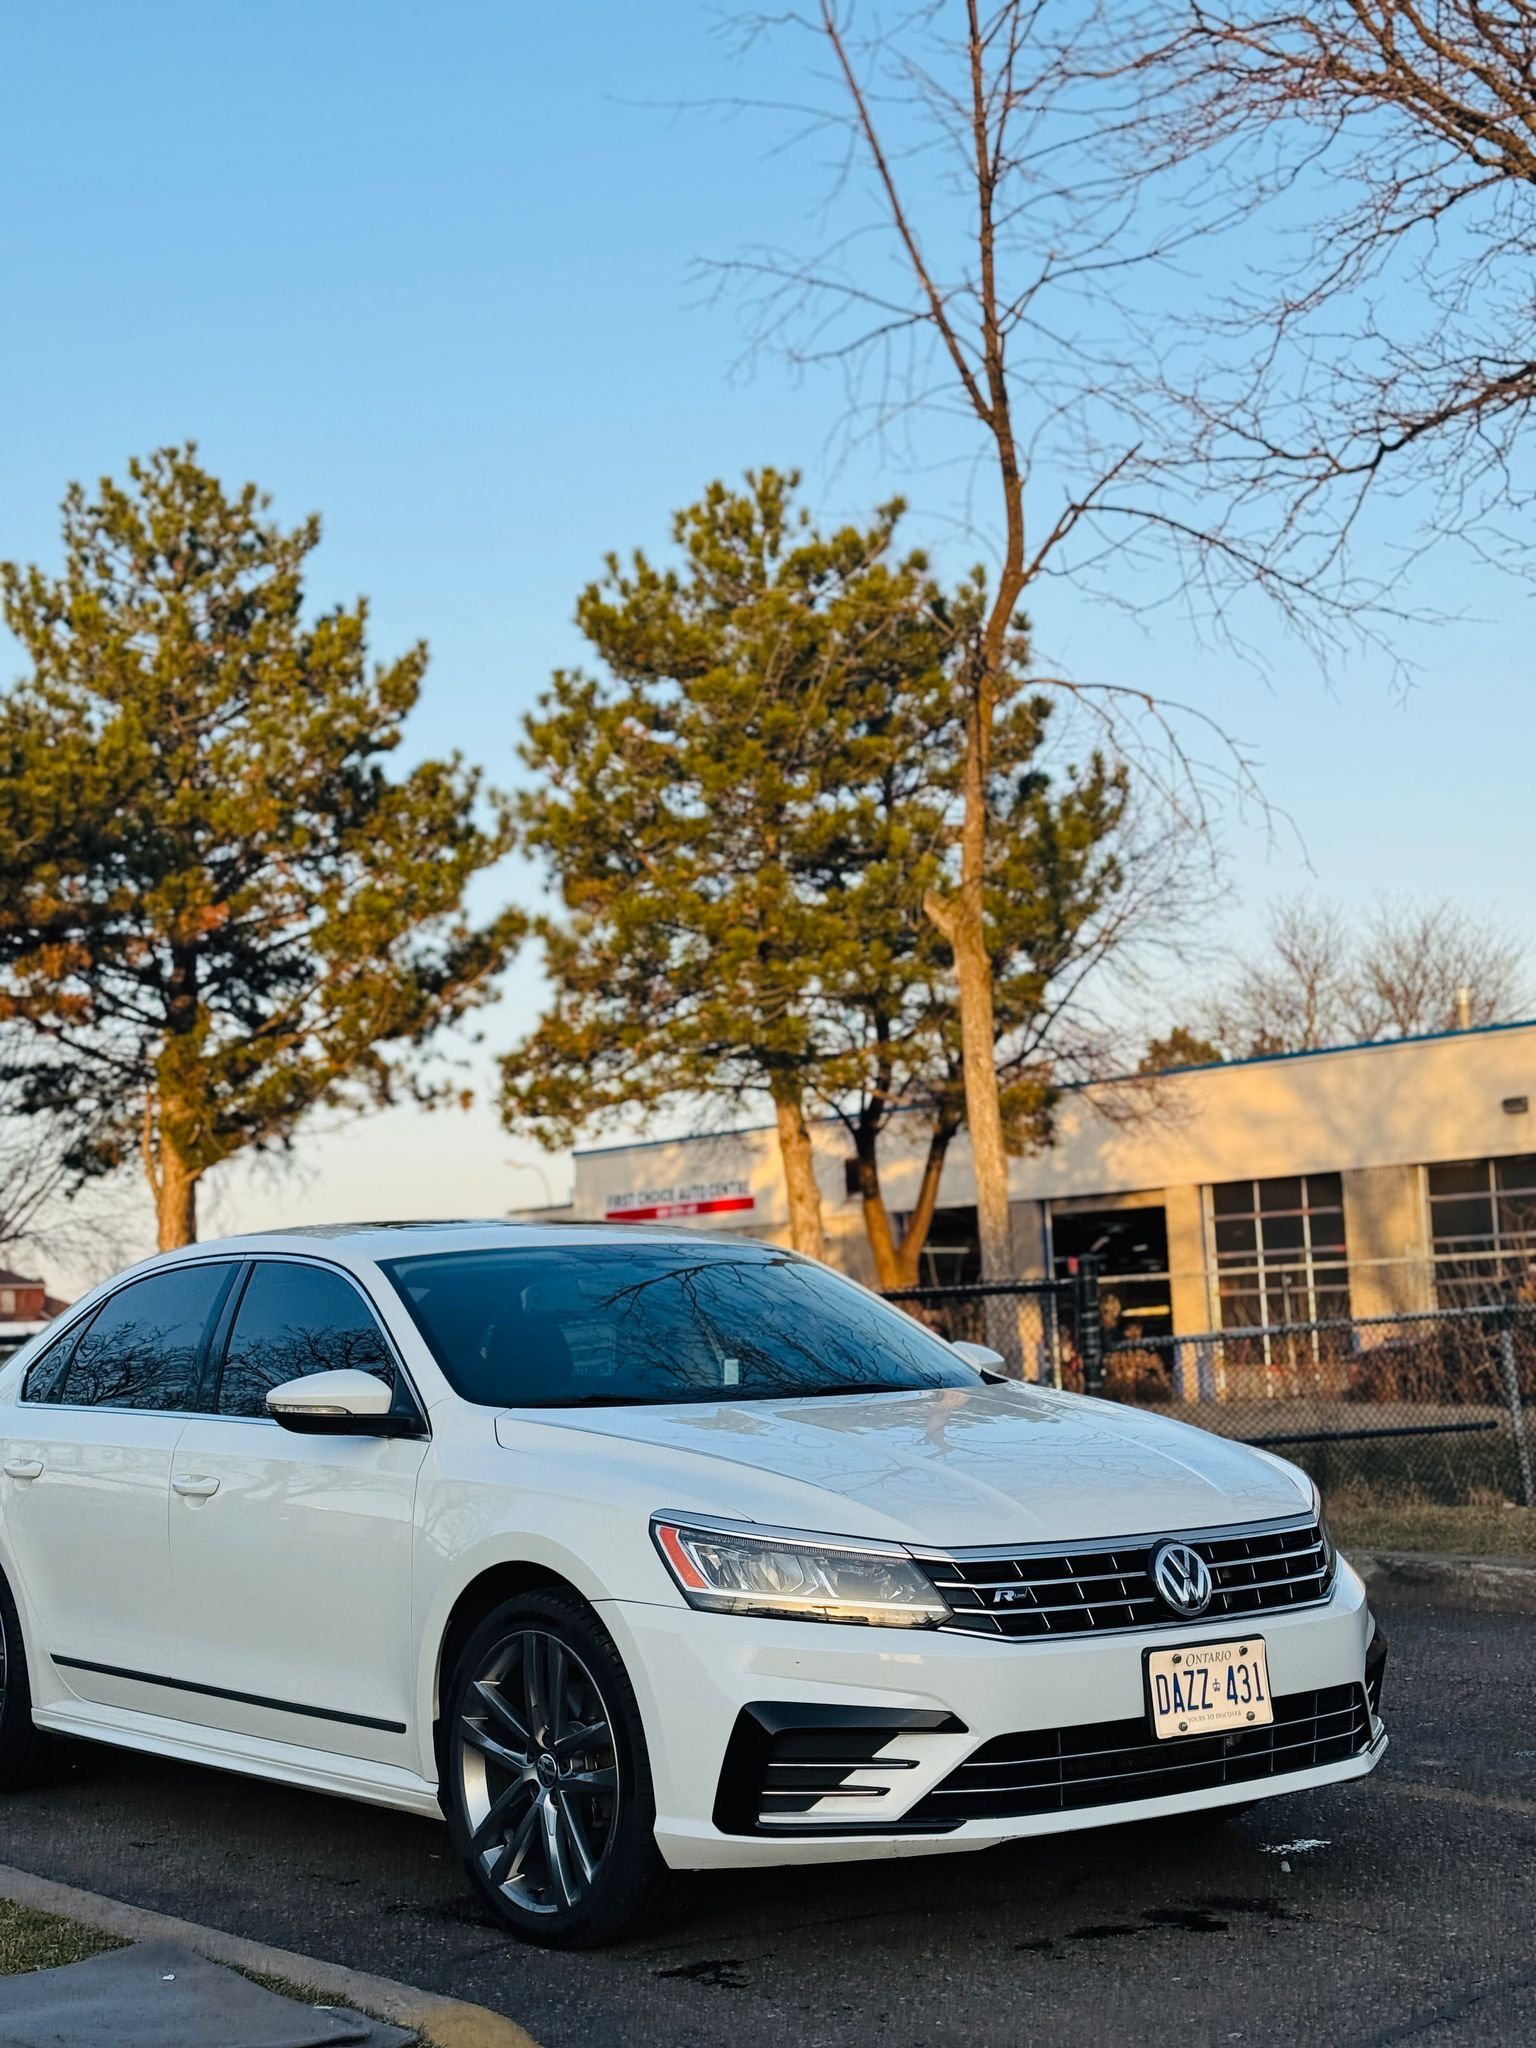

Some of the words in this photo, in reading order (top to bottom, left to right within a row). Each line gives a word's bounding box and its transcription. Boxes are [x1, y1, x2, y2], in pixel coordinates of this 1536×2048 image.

[678, 1184, 706, 1201] AUTO
[1185, 1650, 1232, 1667] ONTARIO
[1155, 1668, 1213, 1715] DAZZ
[1226, 1662, 1265, 1705] 431
